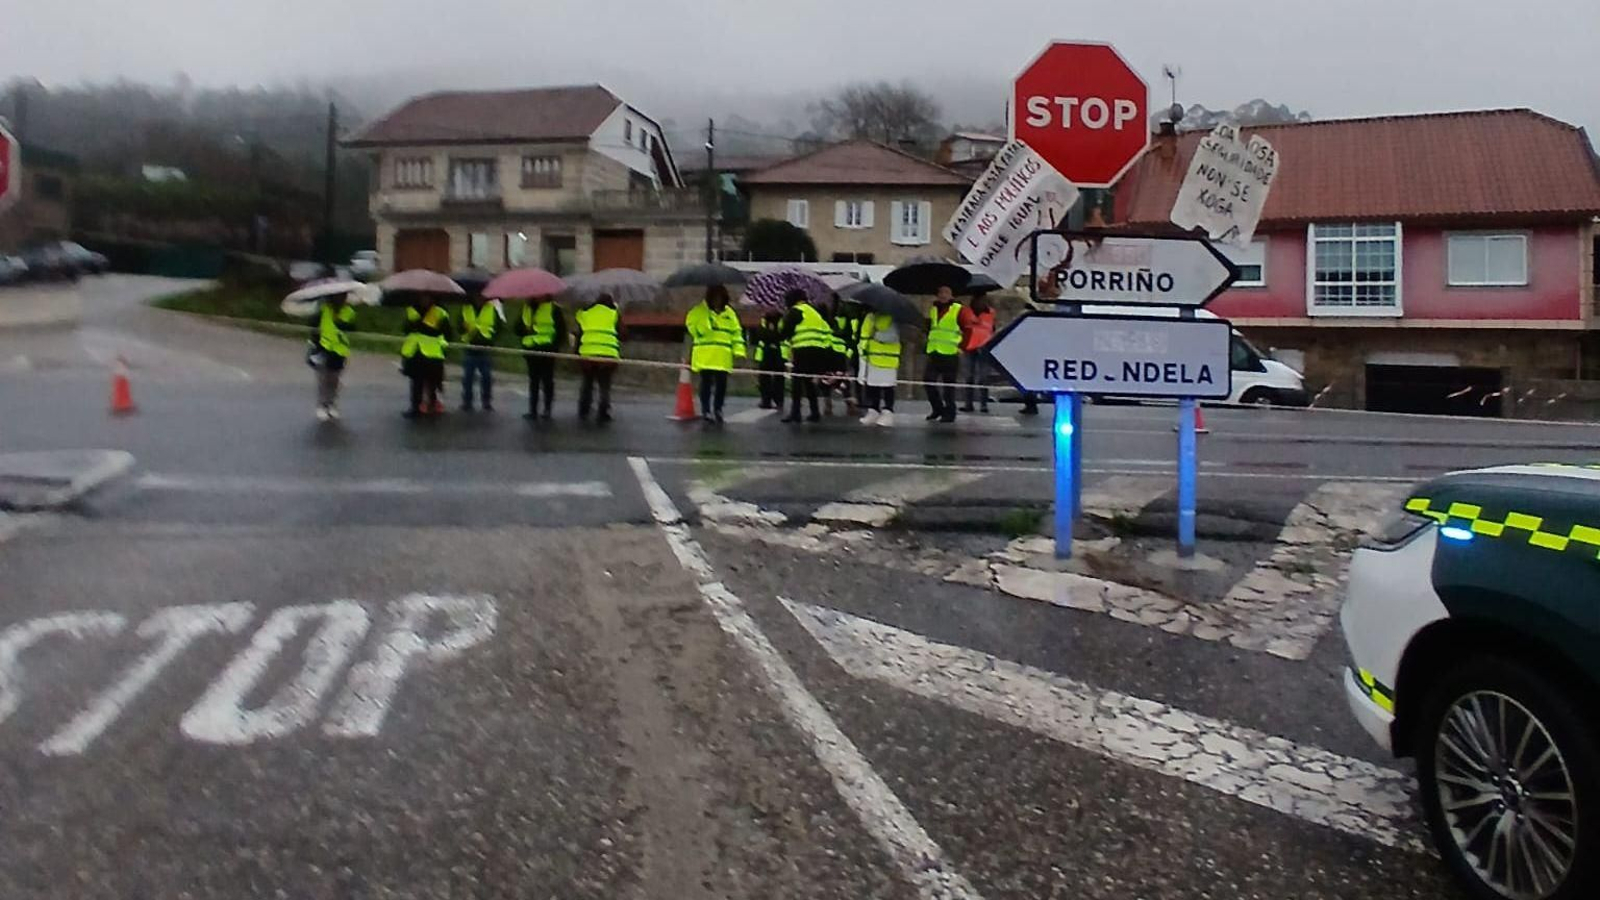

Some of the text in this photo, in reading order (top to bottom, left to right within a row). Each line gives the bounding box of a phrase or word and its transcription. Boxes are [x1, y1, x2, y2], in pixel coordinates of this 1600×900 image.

[1026, 95, 1137, 130] STOP
[977, 212, 998, 236] AOS
[994, 157, 1042, 211] POLÍTICOS
[1197, 163, 1250, 202] NON SE
[1198, 188, 1233, 219] XOGA
[980, 195, 1040, 267] DALLE IGUAL
[1056, 268, 1174, 292] PORRIÑO
[1044, 359, 1213, 384] REDNDELA
